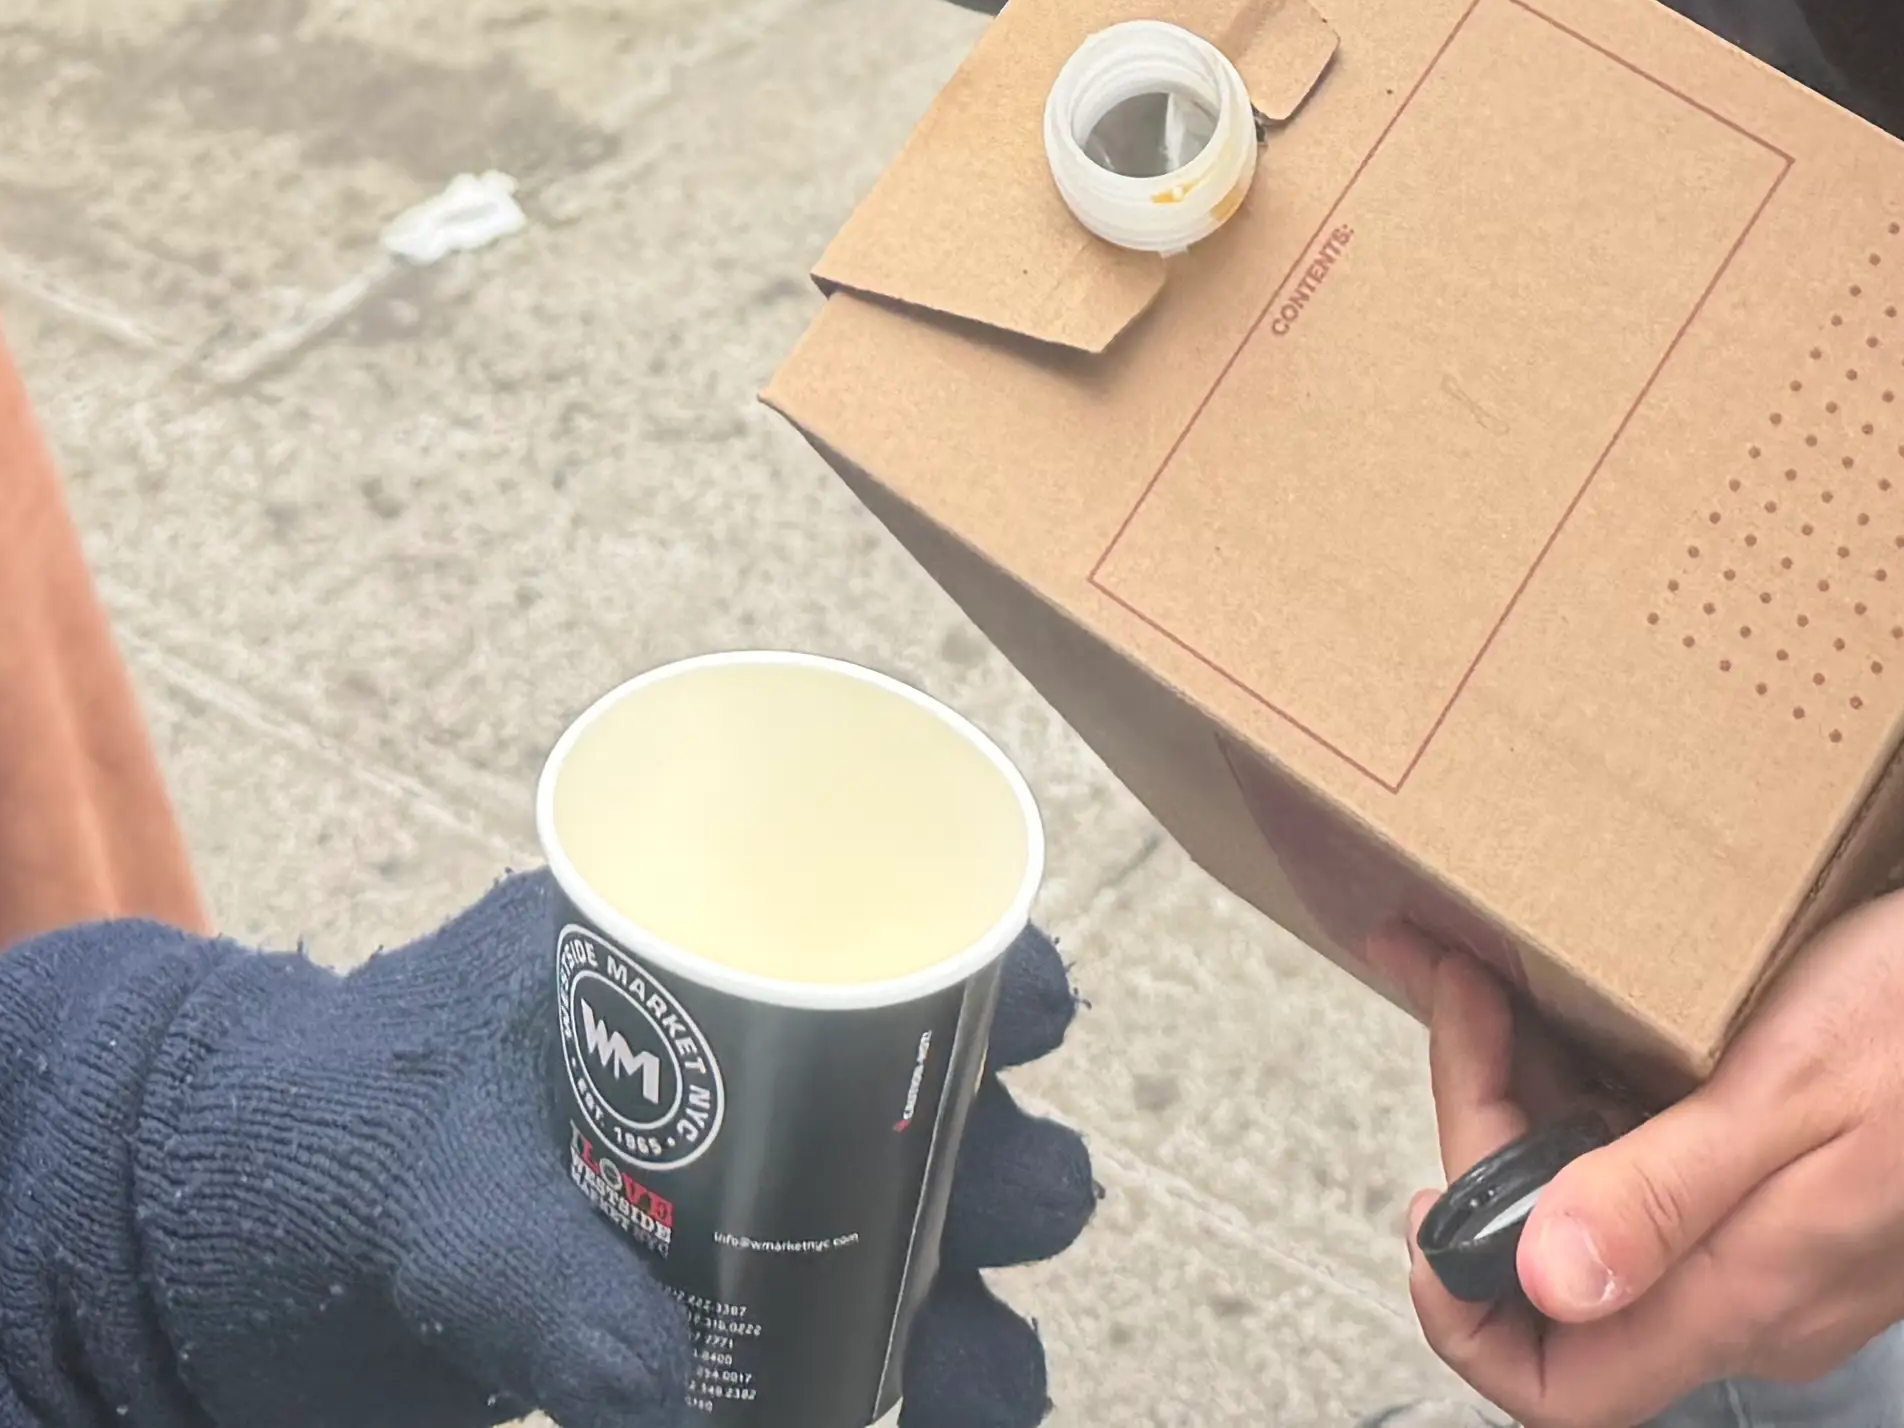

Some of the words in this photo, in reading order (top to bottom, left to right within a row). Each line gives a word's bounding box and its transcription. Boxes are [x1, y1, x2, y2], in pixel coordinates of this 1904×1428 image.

[1271, 223, 1355, 336] CONTENTS:
[581, 998, 660, 1104] WM
[607, 955, 706, 1074] MARKET
[676, 1084, 711, 1143] NYC
